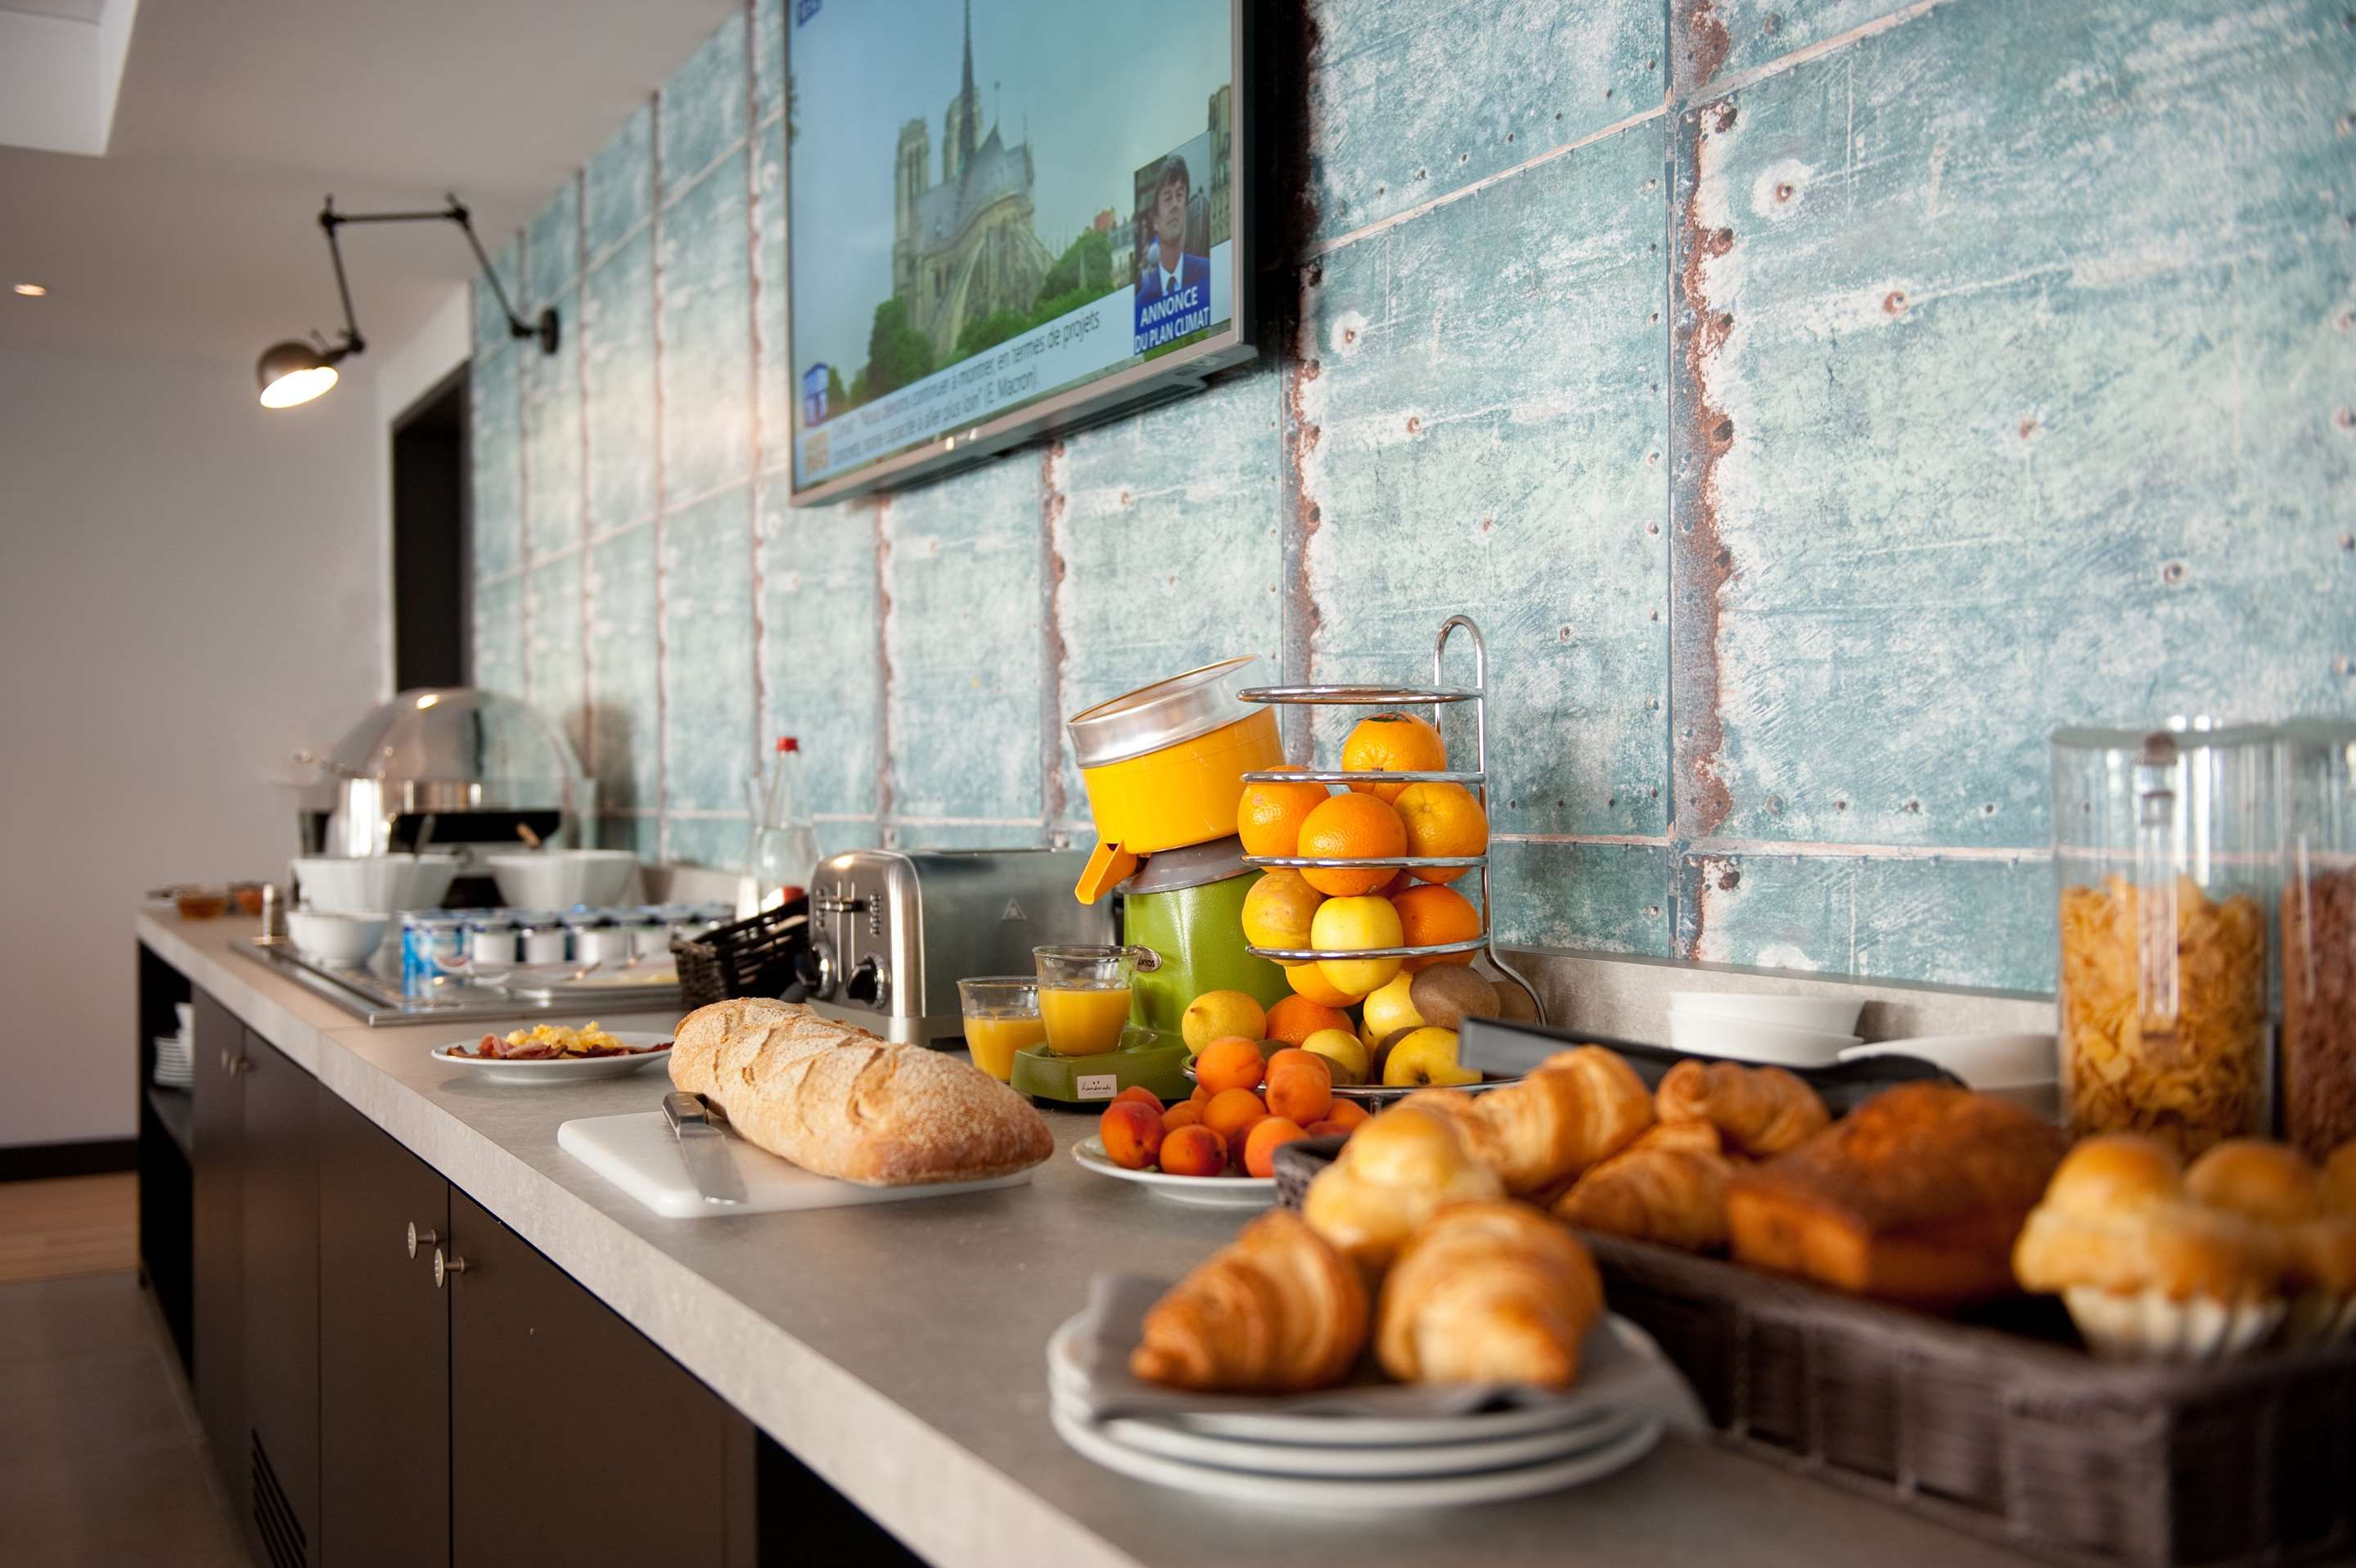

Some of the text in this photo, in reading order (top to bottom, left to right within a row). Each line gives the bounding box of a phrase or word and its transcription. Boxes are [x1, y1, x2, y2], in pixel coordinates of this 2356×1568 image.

[1140, 286, 1198, 327] ANNONCE
[997, 351, 1010, 371] en
[1047, 323, 1061, 349] de
[1063, 310, 1100, 350] projets
[1134, 306, 1210, 354] DU PLAN CLIMAT
[1136, 958, 1155, 967] ANTOS
